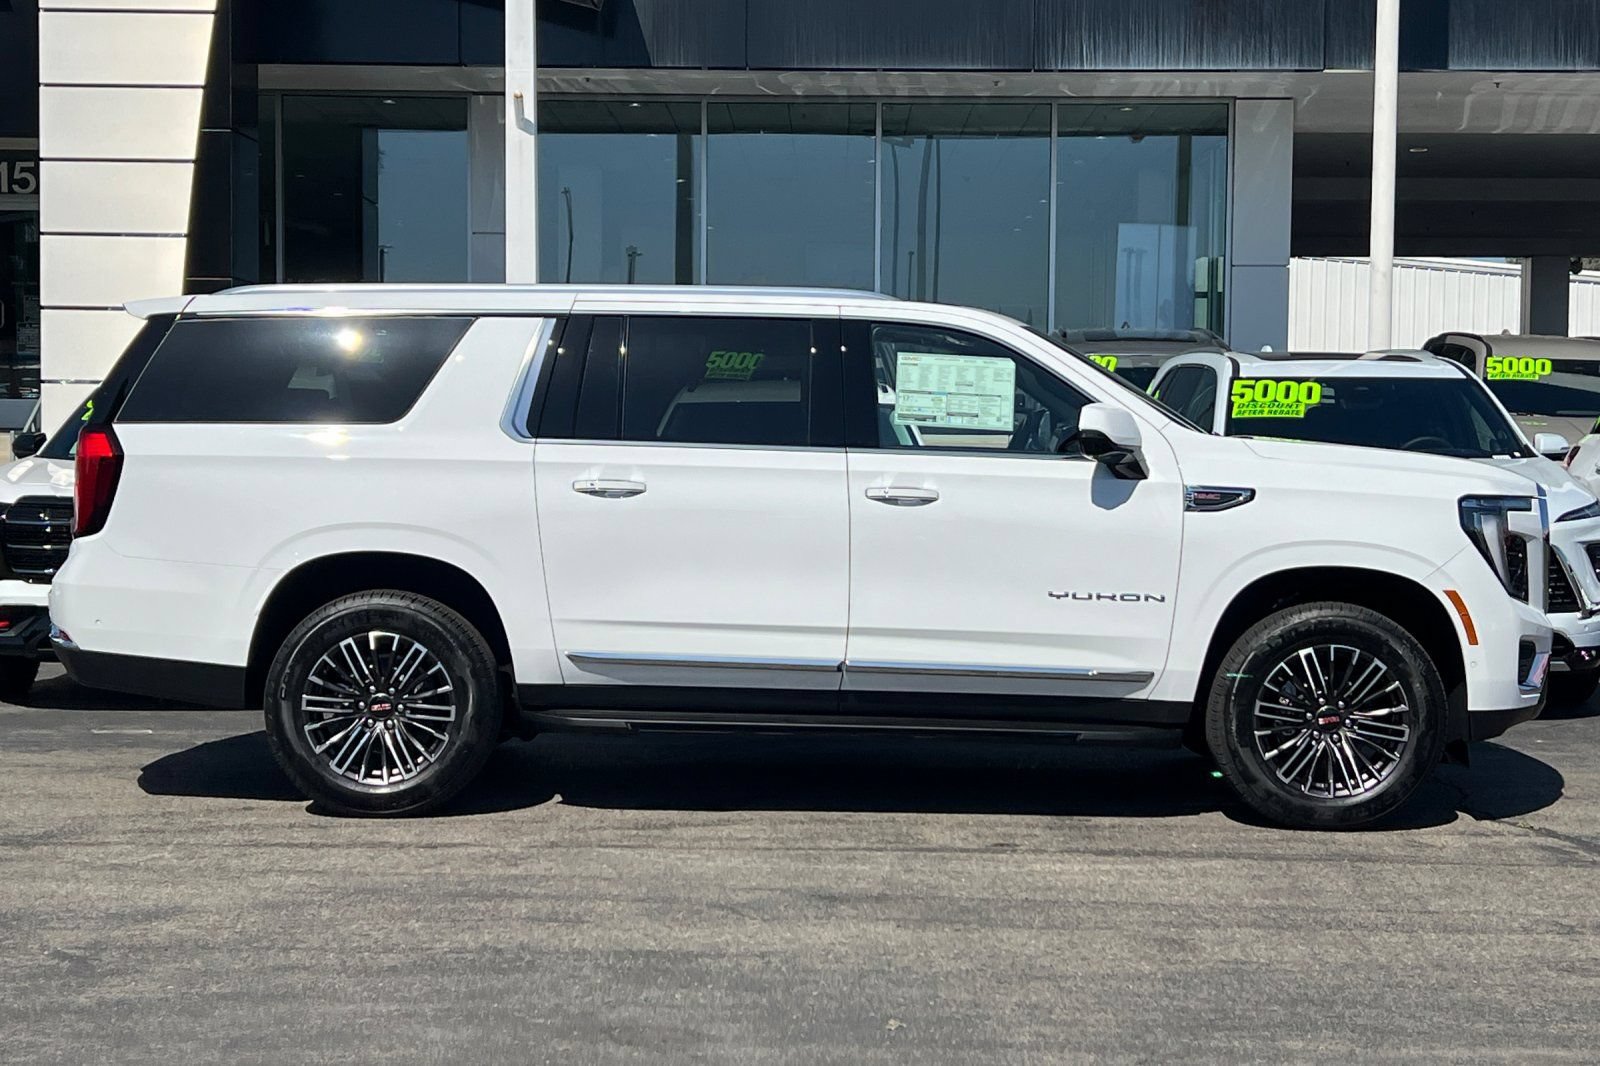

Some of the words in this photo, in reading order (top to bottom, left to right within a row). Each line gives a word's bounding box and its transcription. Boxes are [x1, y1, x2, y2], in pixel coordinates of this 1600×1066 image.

[0, 161, 37, 194] 15
[1486, 356, 1552, 375] 5000
[1231, 379, 1321, 404] 5000
[1048, 591, 1165, 602] YUKON
